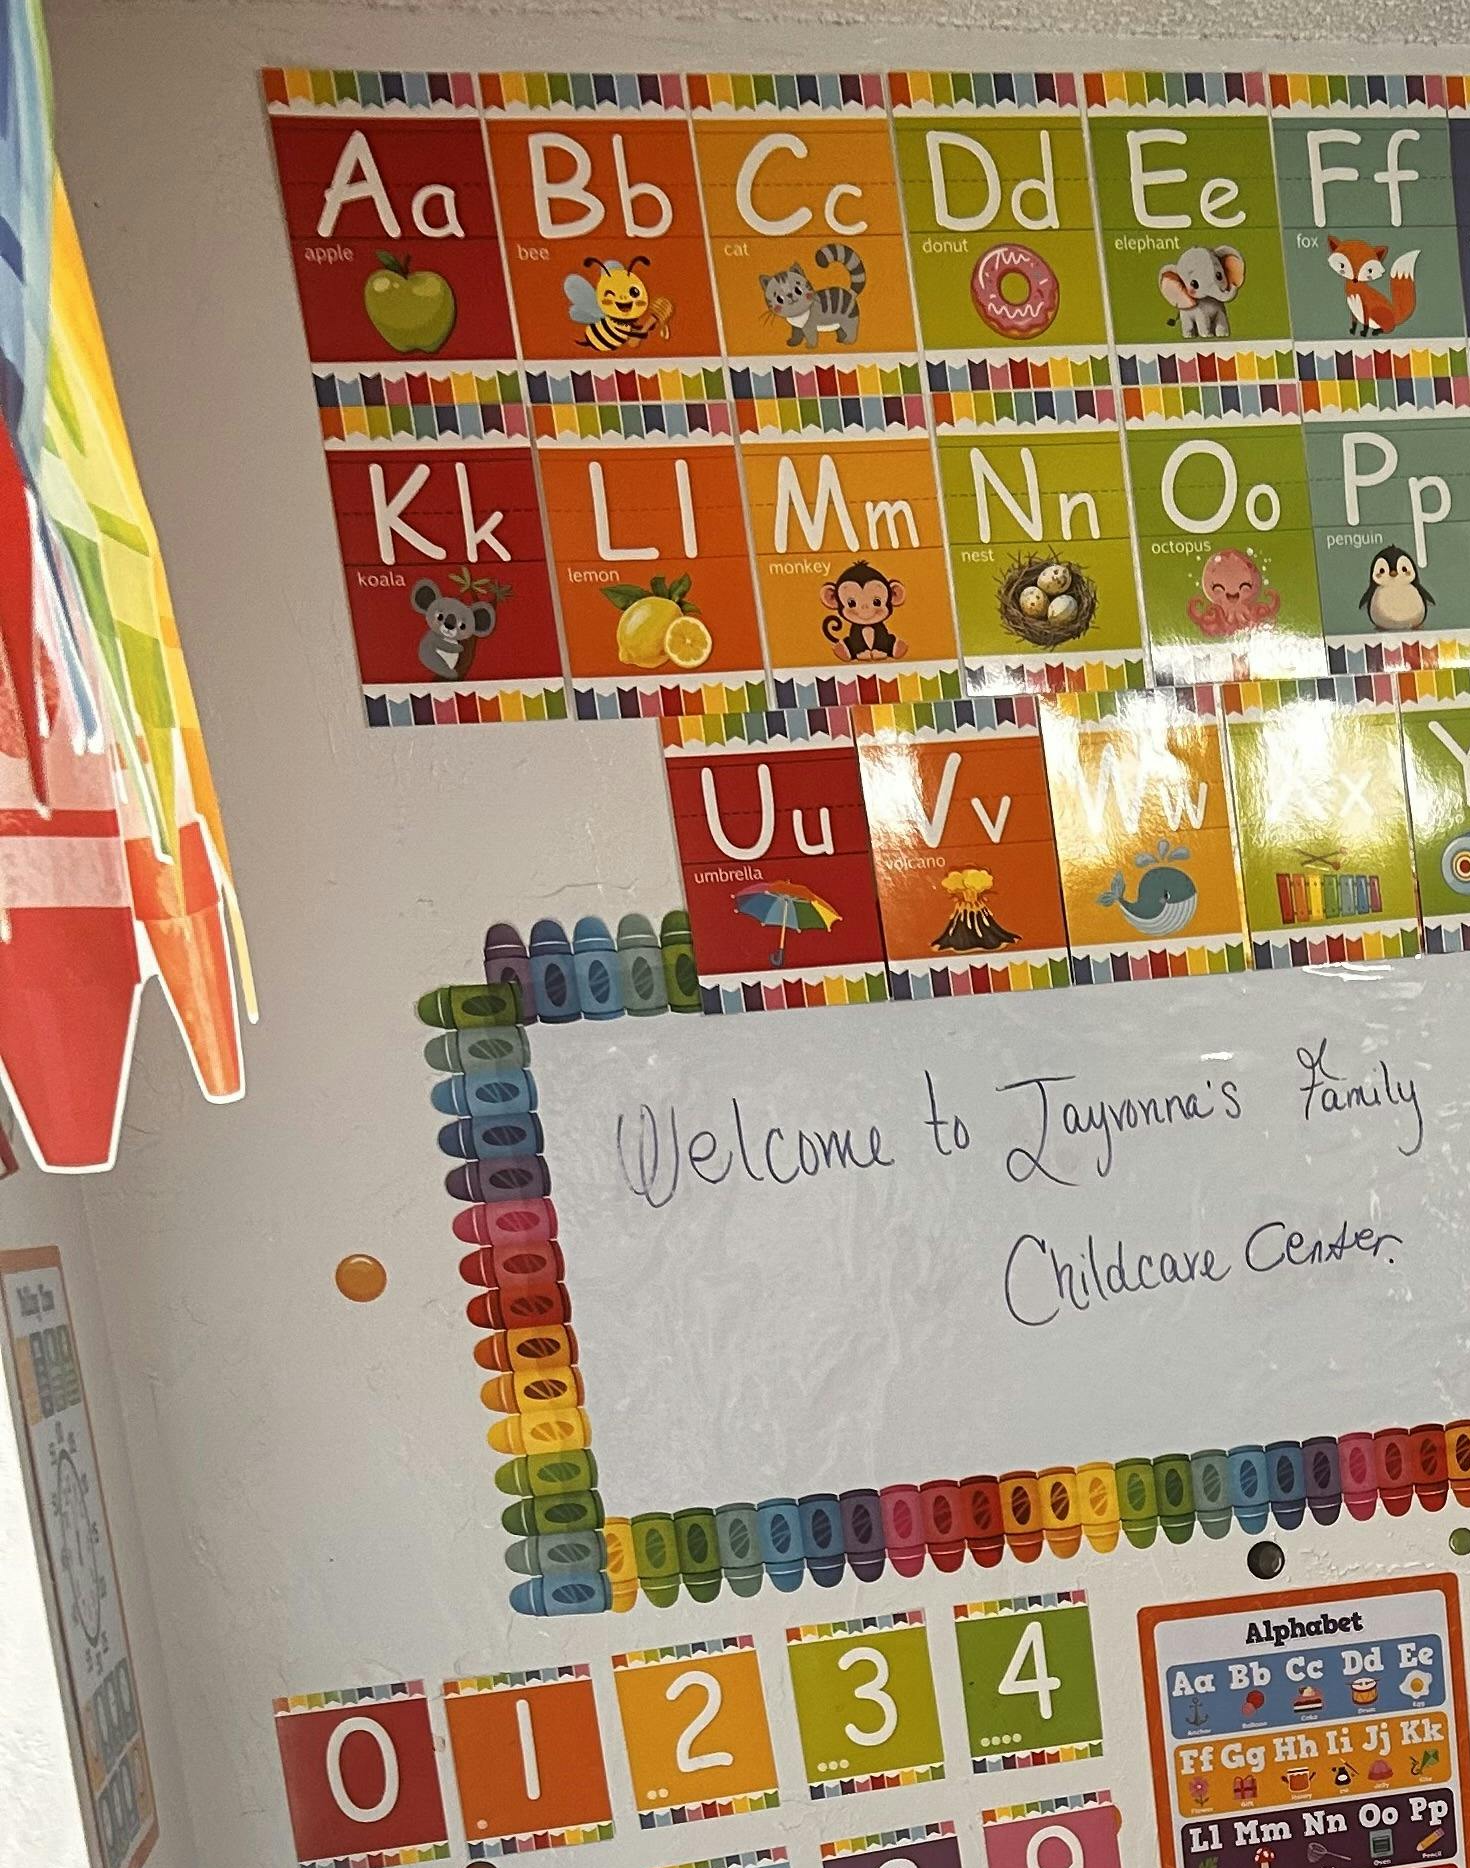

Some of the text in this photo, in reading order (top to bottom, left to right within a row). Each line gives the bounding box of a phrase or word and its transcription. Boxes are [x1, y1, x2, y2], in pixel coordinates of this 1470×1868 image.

[317, 129, 465, 240] Aa
[527, 131, 675, 239] Bb
[735, 131, 869, 236] Cc
[926, 129, 1061, 231] Dd
[1126, 129, 1247, 230] Ee
[1307, 129, 1421, 229] Ff
[304, 245, 354, 264] apple
[516, 245, 550, 261] bee
[723, 242, 750, 257] cat
[921, 237, 969, 255] donut
[1114, 234, 1181, 252] elephant
[1296, 233, 1319, 249] fox
[368, 461, 512, 566] Kk
[774, 454, 920, 554] Mm
[969, 448, 1101, 544] Nn
[1160, 440, 1282, 534] Oo
[1342, 433, 1453, 568] Pp
[357, 570, 406, 588] koala
[567, 568, 620, 585] lemon
[769, 558, 833, 578] monkey
[961, 548, 995, 563] nest
[1151, 539, 1212, 556] octopus
[1327, 530, 1384, 549] penguin
[700, 763, 834, 861] Uu
[693, 863, 763, 885] umbrella
[617, 1098, 894, 1208] Welcome
[925, 1071, 969, 1155] to
[1297, 1037, 1421, 1156] Family
[1004, 1234, 1231, 1326] Childcare
[998, 1621, 1061, 1720] 4
[1171, 1644, 1434, 1697] Aa Bb Cc Dd Ee
[1245, 1612, 1364, 1646] Alphabet
[666, 1671, 734, 1773] 2
[838, 1647, 899, 1746] 3
[516, 1699, 540, 1800] 1
